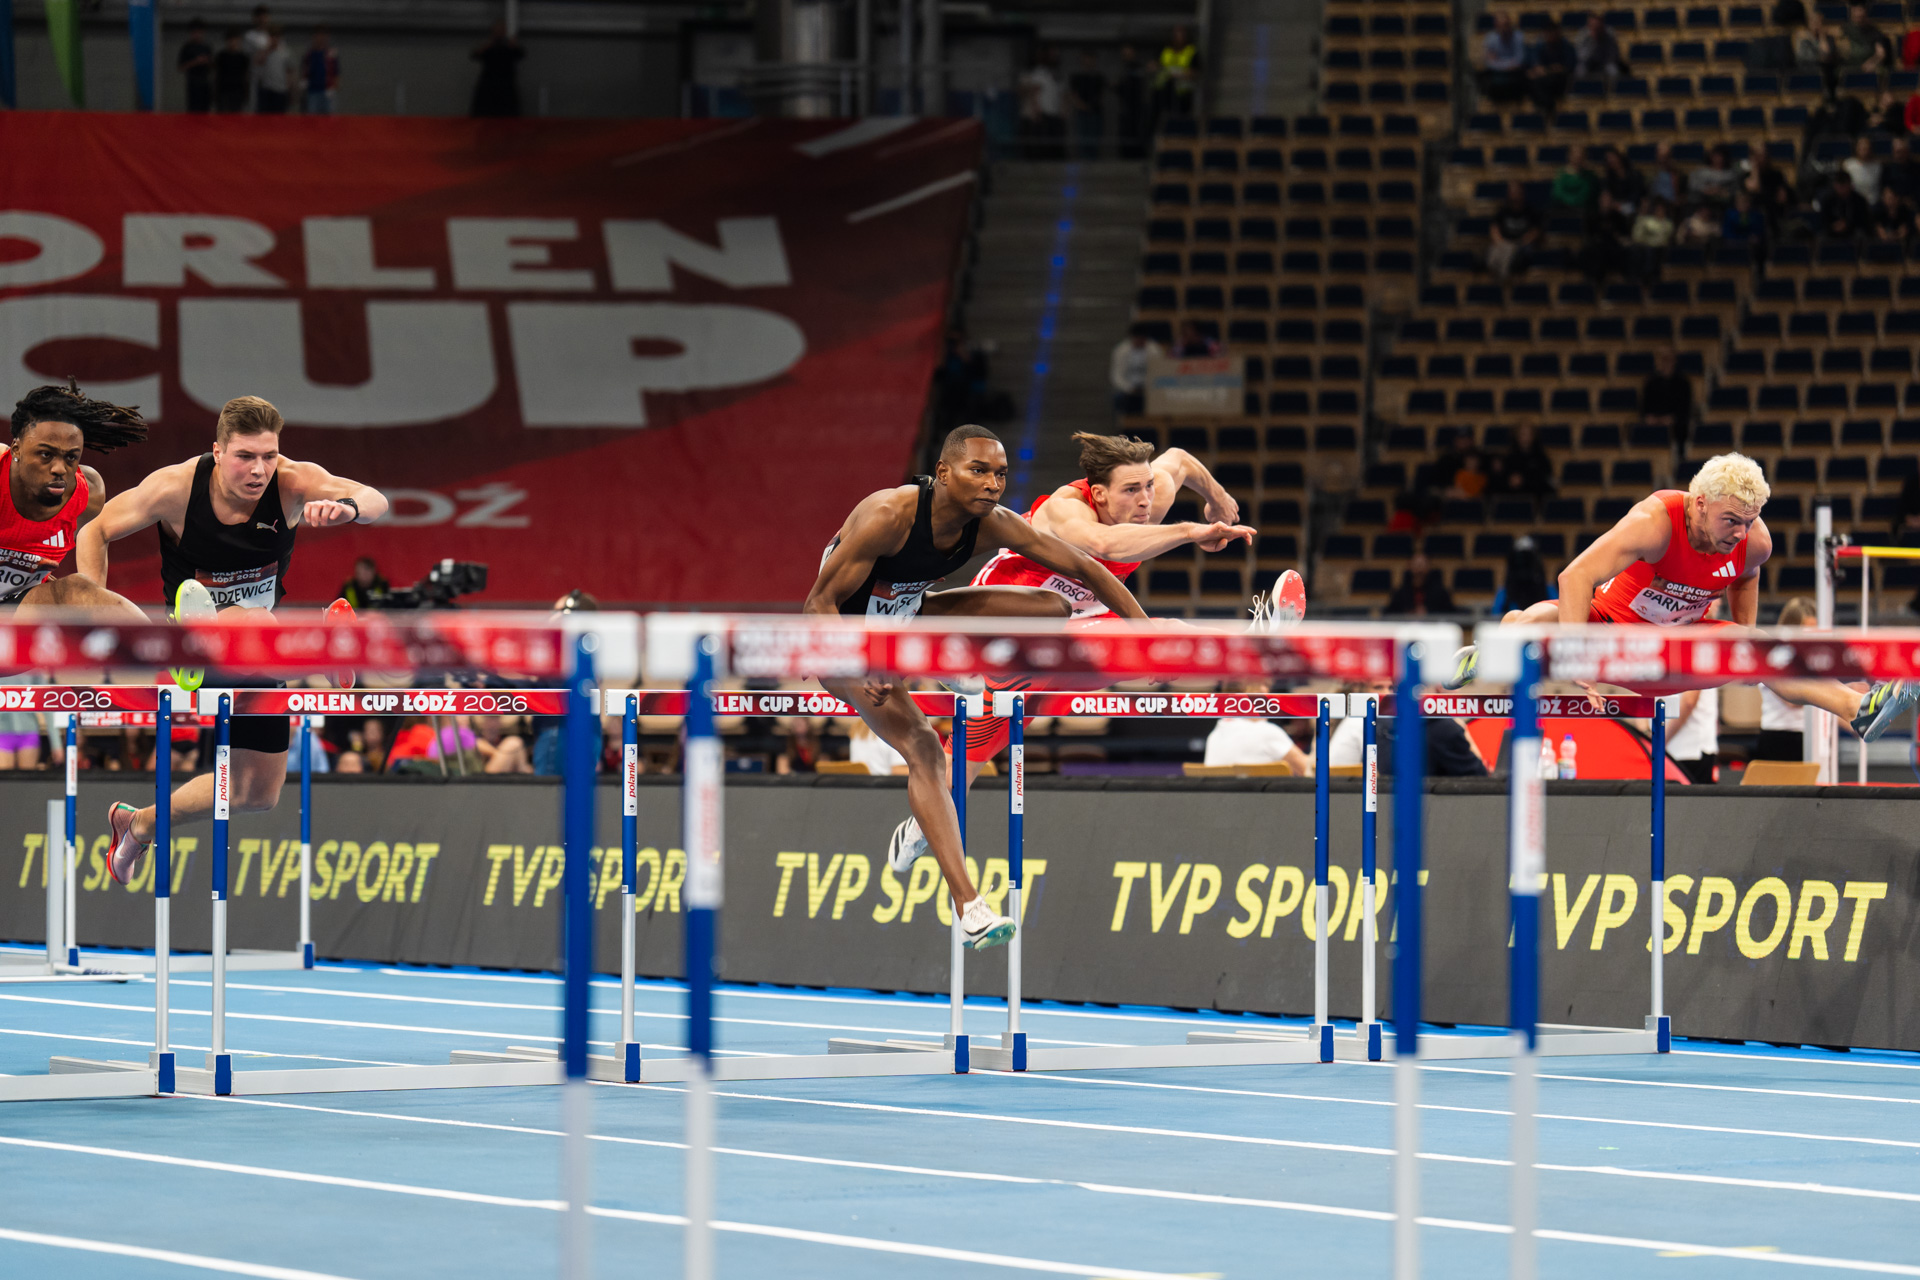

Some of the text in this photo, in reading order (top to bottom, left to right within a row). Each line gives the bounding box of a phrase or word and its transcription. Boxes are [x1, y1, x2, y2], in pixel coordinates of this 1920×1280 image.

[0, 211, 791, 290] ORLEN
[0, 295, 806, 428] CUP
[370, 482, 531, 528] DŹ
[0, 548, 42, 563] RLEN CUP
[209, 579, 274, 605] ADZEWICZ
[1666, 582, 1712, 597] ORLEN CUP
[0, 687, 112, 709] DŹ 2026
[288, 690, 528, 712] ORLEN CUP ŁÓDŹ 2026
[710, 695, 754, 713] RLEN
[758, 696, 794, 713] CUP
[1071, 693, 1280, 714] ORLEN CUP ŁÓDŹ 2026
[1423, 698, 1479, 715] ORLEN
[1483, 698, 1513, 714] CUP
[1537, 695, 1562, 715] DŹ
[219, 763, 228, 801] polanik
[628, 761, 636, 798] polanik
[1015, 761, 1023, 796] polanik
[234, 838, 440, 903] TVP SPORT
[483, 844, 566, 908] TVP
[773, 851, 870, 920] TVP
[1110, 861, 1222, 935] TVP
[1646, 874, 1888, 962] SPORT
